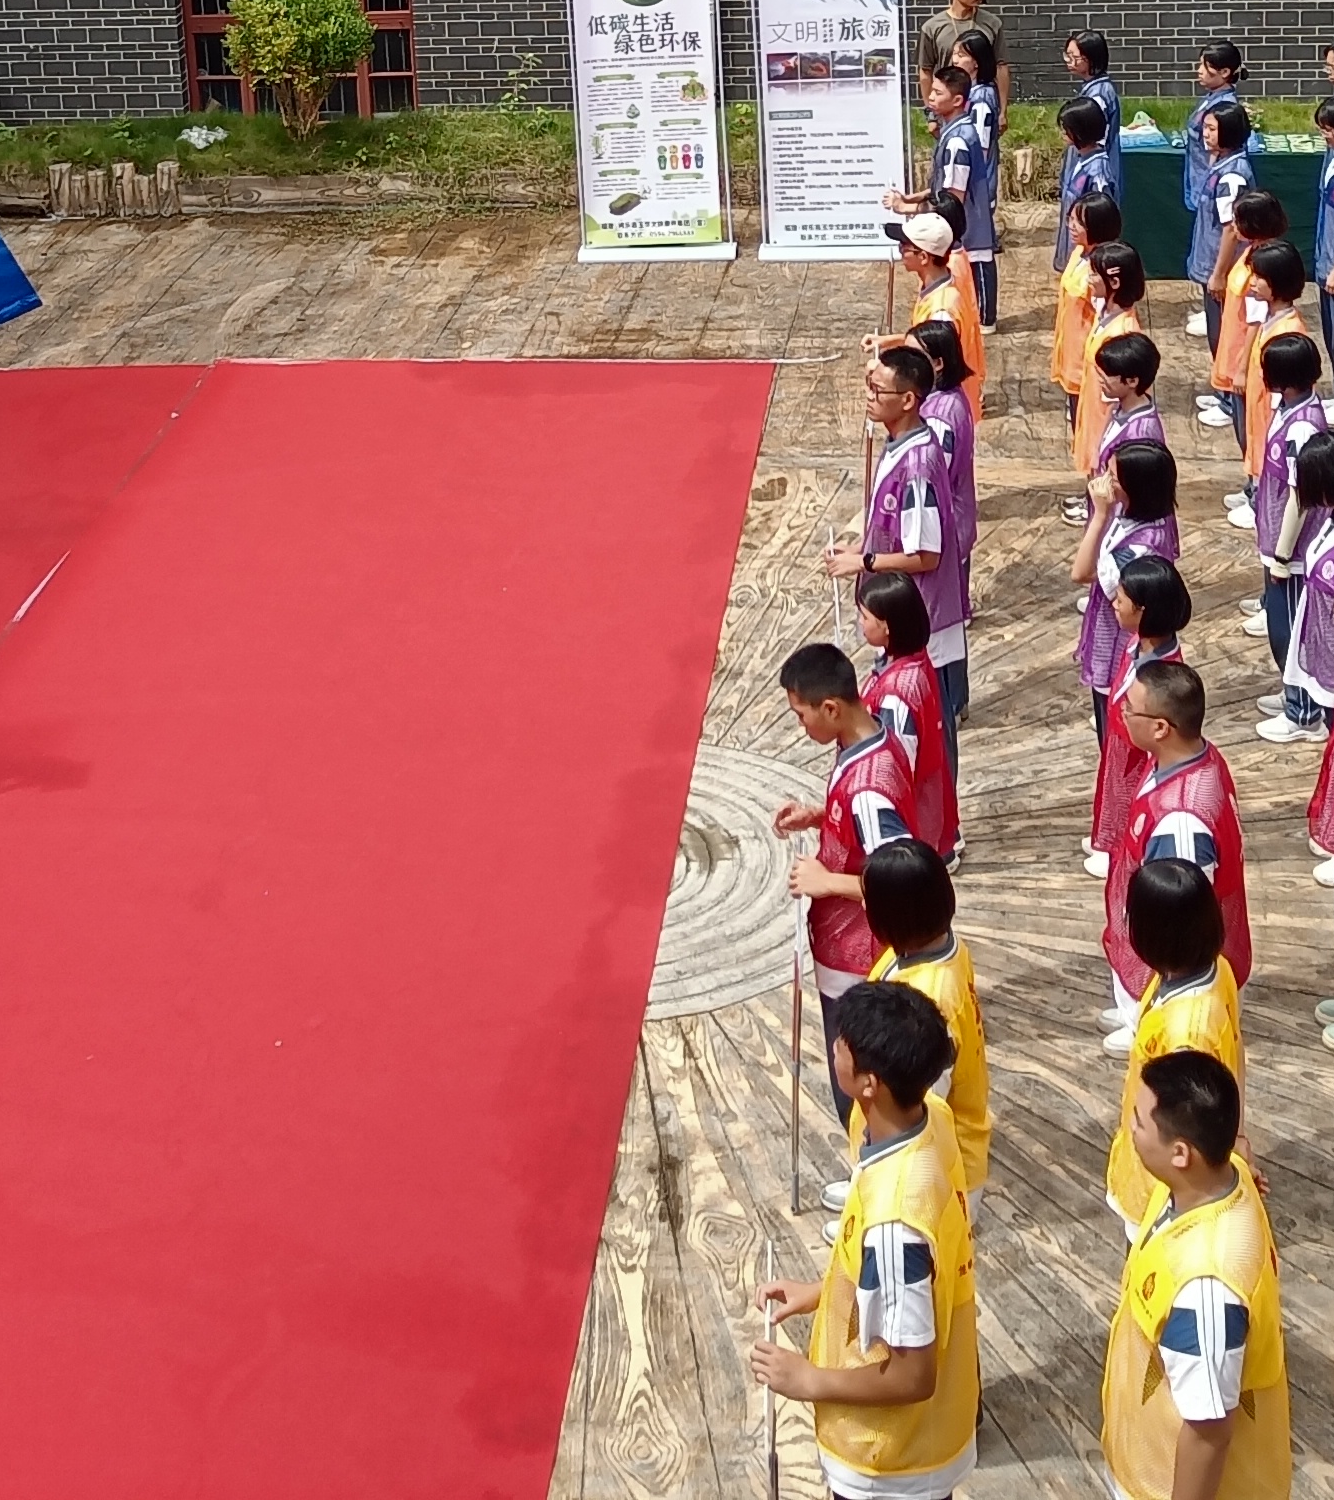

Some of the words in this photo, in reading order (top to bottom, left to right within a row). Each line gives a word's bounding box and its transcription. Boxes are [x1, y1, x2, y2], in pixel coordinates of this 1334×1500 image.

[587, 12, 675, 37] 低碳生活
[766, 21, 819, 44] 文明
[838, 16, 894, 42] 旅游
[614, 31, 702, 55] 绿色环保
